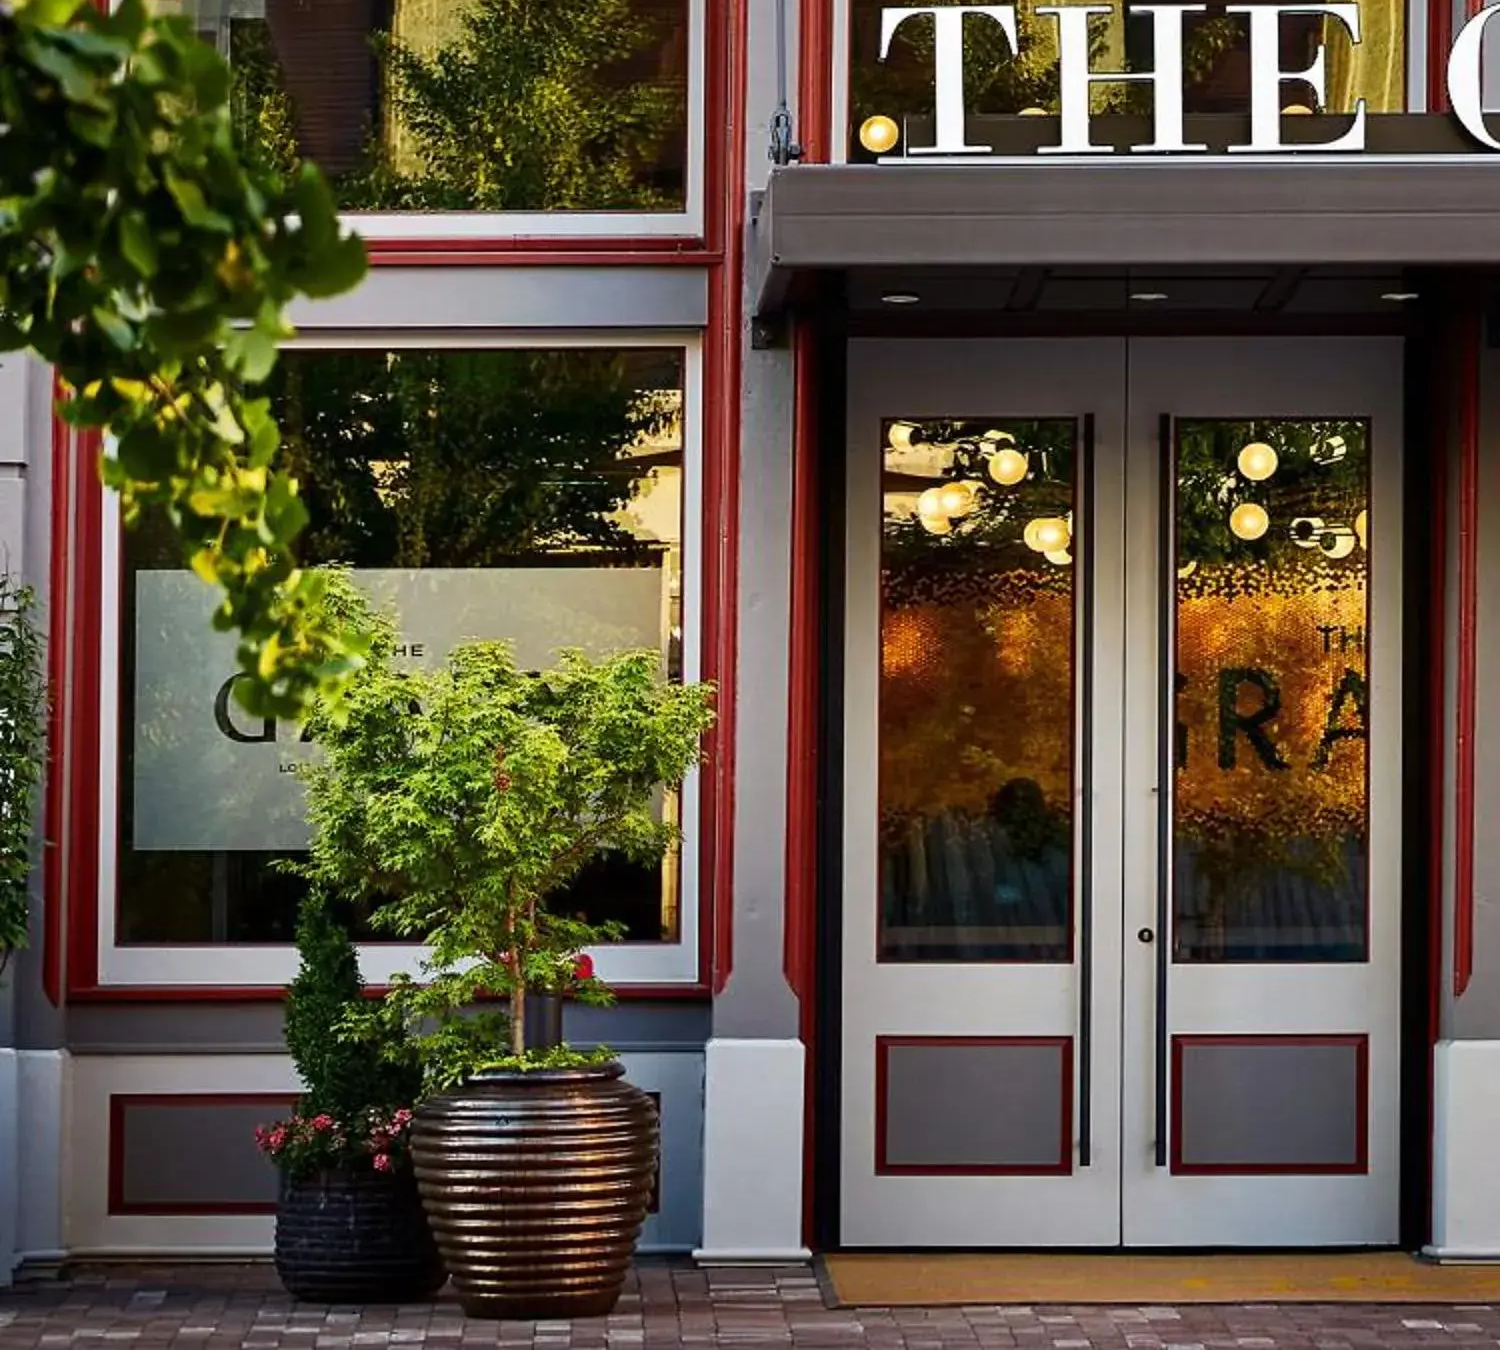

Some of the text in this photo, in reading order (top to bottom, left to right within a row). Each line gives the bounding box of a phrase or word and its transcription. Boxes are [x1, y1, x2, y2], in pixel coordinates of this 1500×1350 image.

[879, 4, 1366, 153] THE
[392, 643, 424, 656] HE
[1315, 625, 1363, 653] TH
